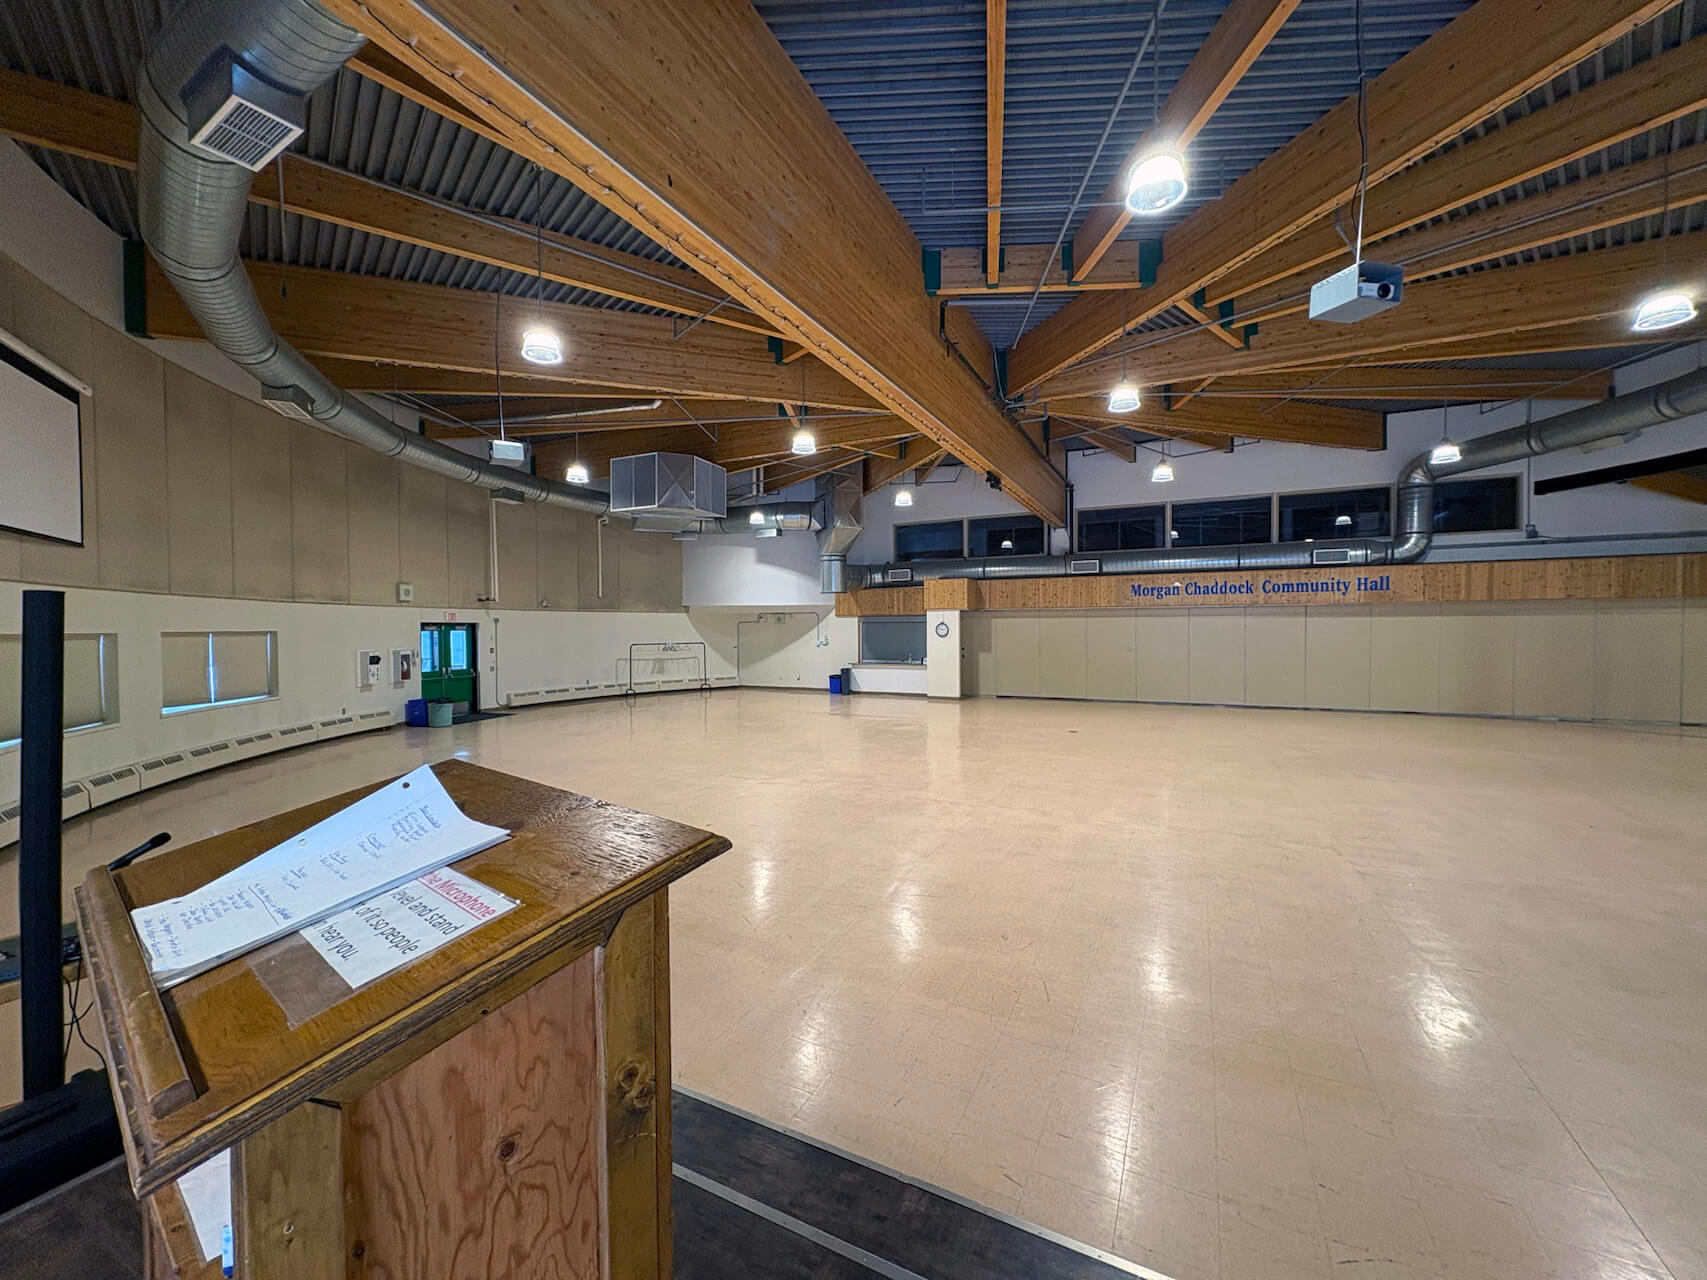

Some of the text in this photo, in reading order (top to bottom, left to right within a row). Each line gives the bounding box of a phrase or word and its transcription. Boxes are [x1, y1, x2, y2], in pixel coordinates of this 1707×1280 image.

[1131, 575, 1390, 599] Morgan Chaddock Community Hall
[436, 879, 497, 918] Microphone
[355, 906, 381, 918] of
[363, 910, 383, 923] it
[391, 887, 465, 936] level and stand
[318, 921, 344, 944] hear
[369, 918, 389, 930] so
[327, 940, 359, 961] you.
[374, 926, 421, 955] people
